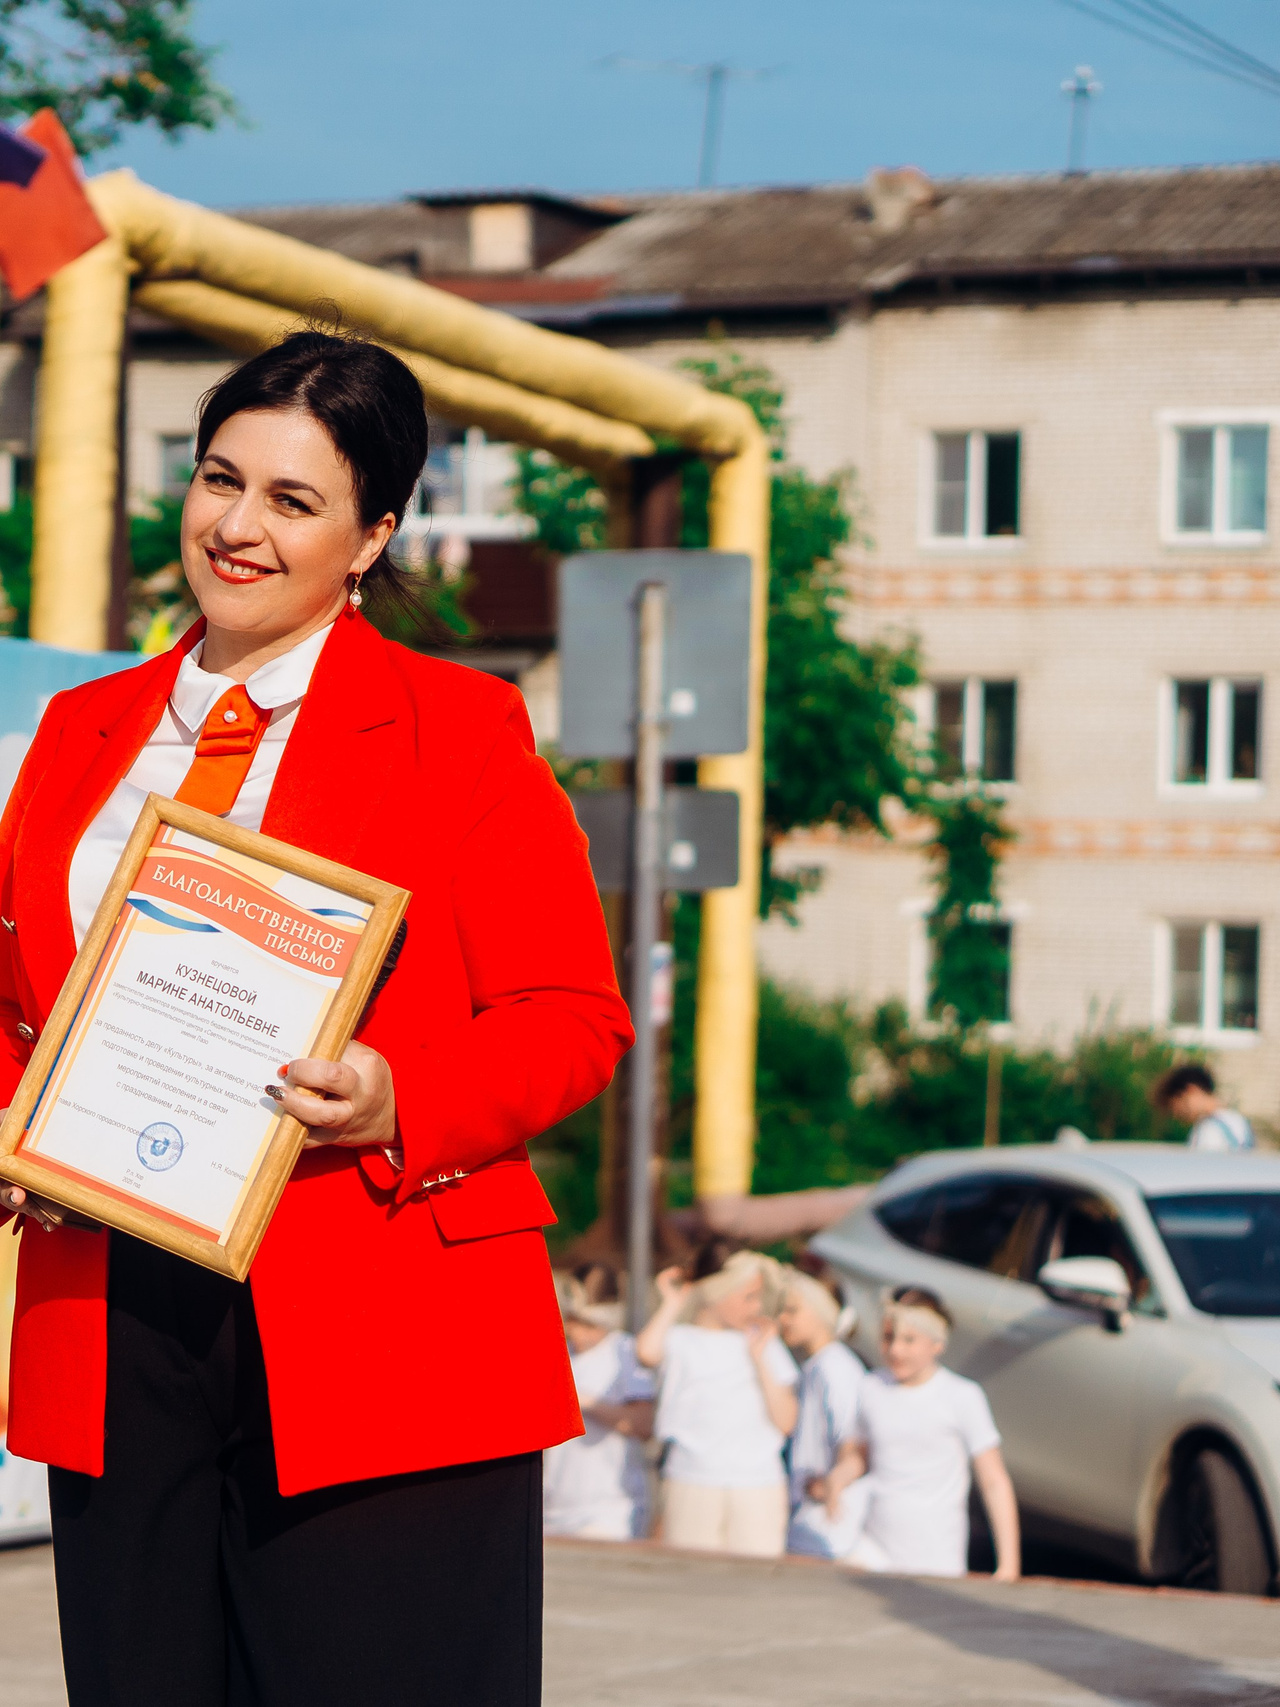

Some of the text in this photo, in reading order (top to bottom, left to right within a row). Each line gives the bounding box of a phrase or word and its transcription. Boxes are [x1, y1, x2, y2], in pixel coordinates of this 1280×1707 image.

[150, 863, 346, 956] БЛАГОДАРСТВЕННОЕ
[210, 959, 240, 976] вручается
[262, 932, 338, 973] ПИСЬМО
[135, 970, 280, 1039] МАРИНЕ АНАТОЛЬЕВНЕ
[174, 962, 259, 1007] КУЗНЕЦОВОЙ
[93, 1019, 103, 1027] за
[101, 1022, 146, 1045] преданность
[144, 1039, 163, 1053] делу
[204, 1064, 214, 1073] за
[213, 1067, 245, 1086] активное
[244, 1080, 267, 1096] участ
[100, 1039, 258, 1109] подготовке и проведении культурных массовых
[115, 1080, 217, 1128] с празднованием Дня России!
[116, 1062, 229, 1115] мероприятий поселения и в связи
[70, 1101, 97, 1119] Хорского
[95, 1113, 127, 1132] городского
